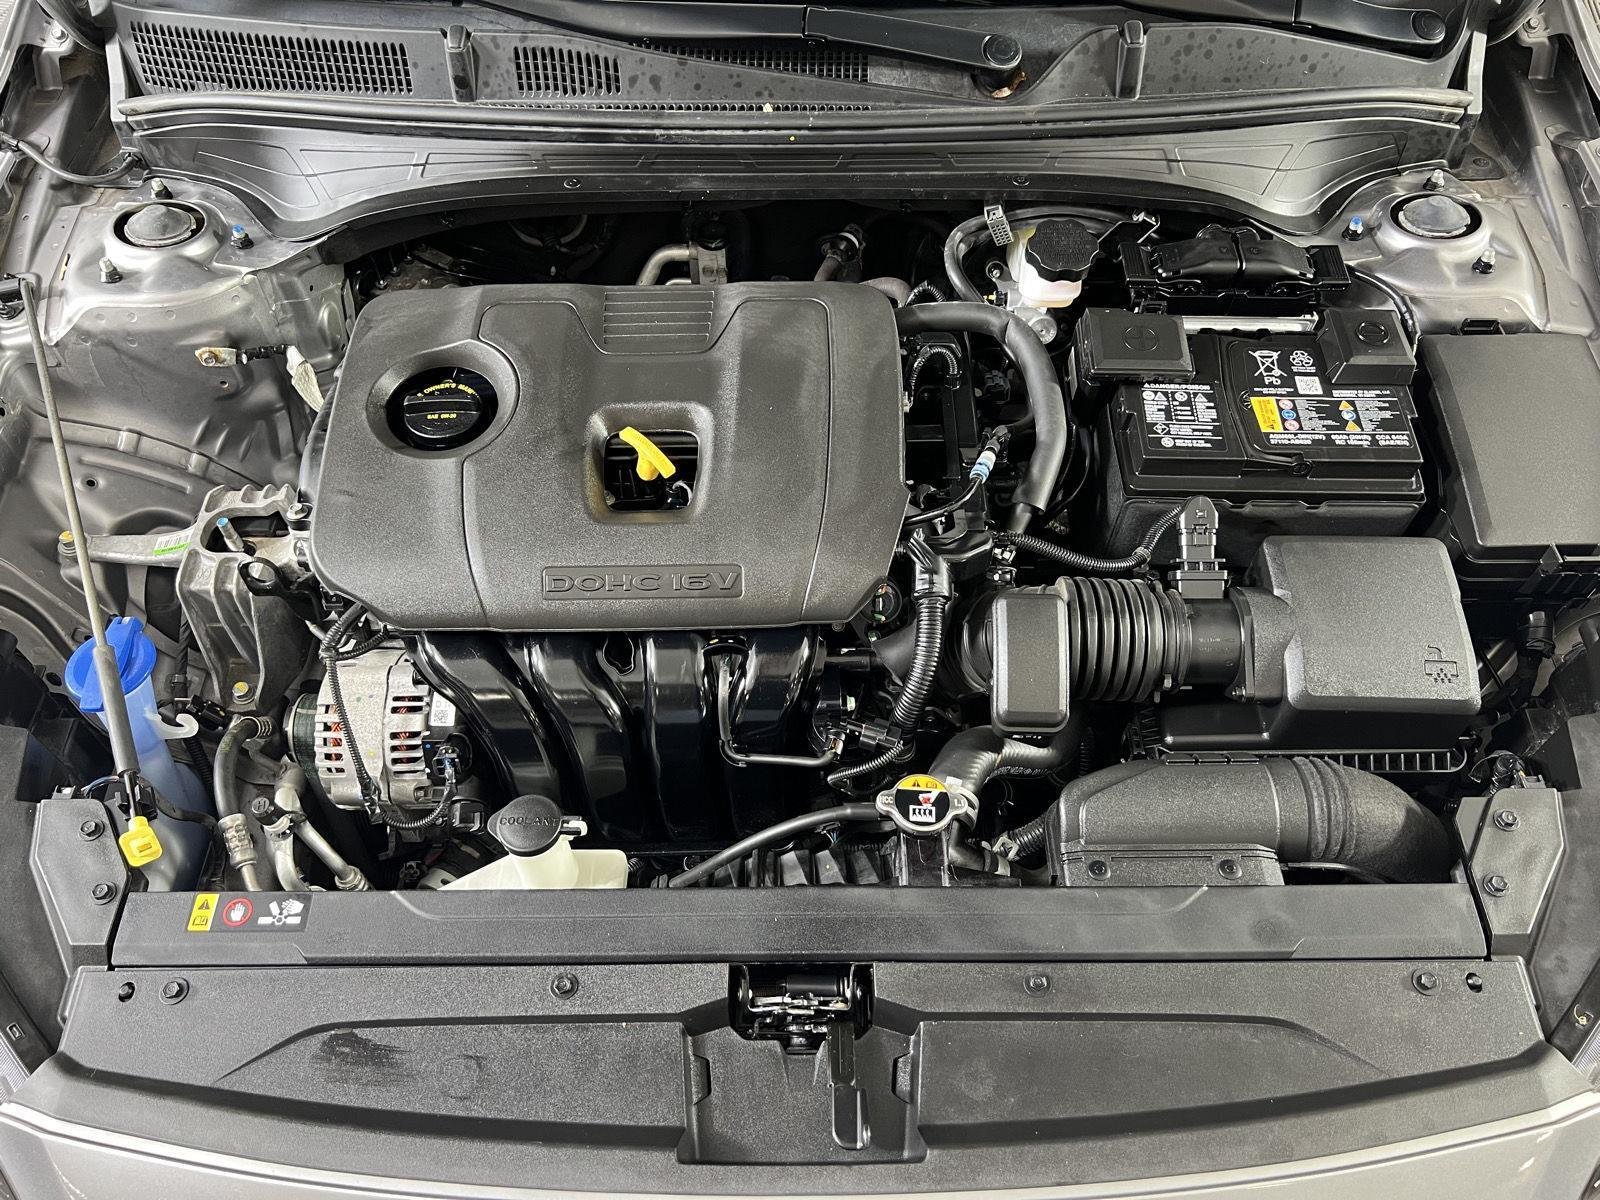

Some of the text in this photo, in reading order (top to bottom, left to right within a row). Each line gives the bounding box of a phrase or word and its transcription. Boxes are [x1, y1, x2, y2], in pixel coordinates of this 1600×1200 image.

[1264, 377, 1281, 385] Pb
[546, 572, 741, 593] DOHC 16V
[500, 816, 559, 826] COOLANT
